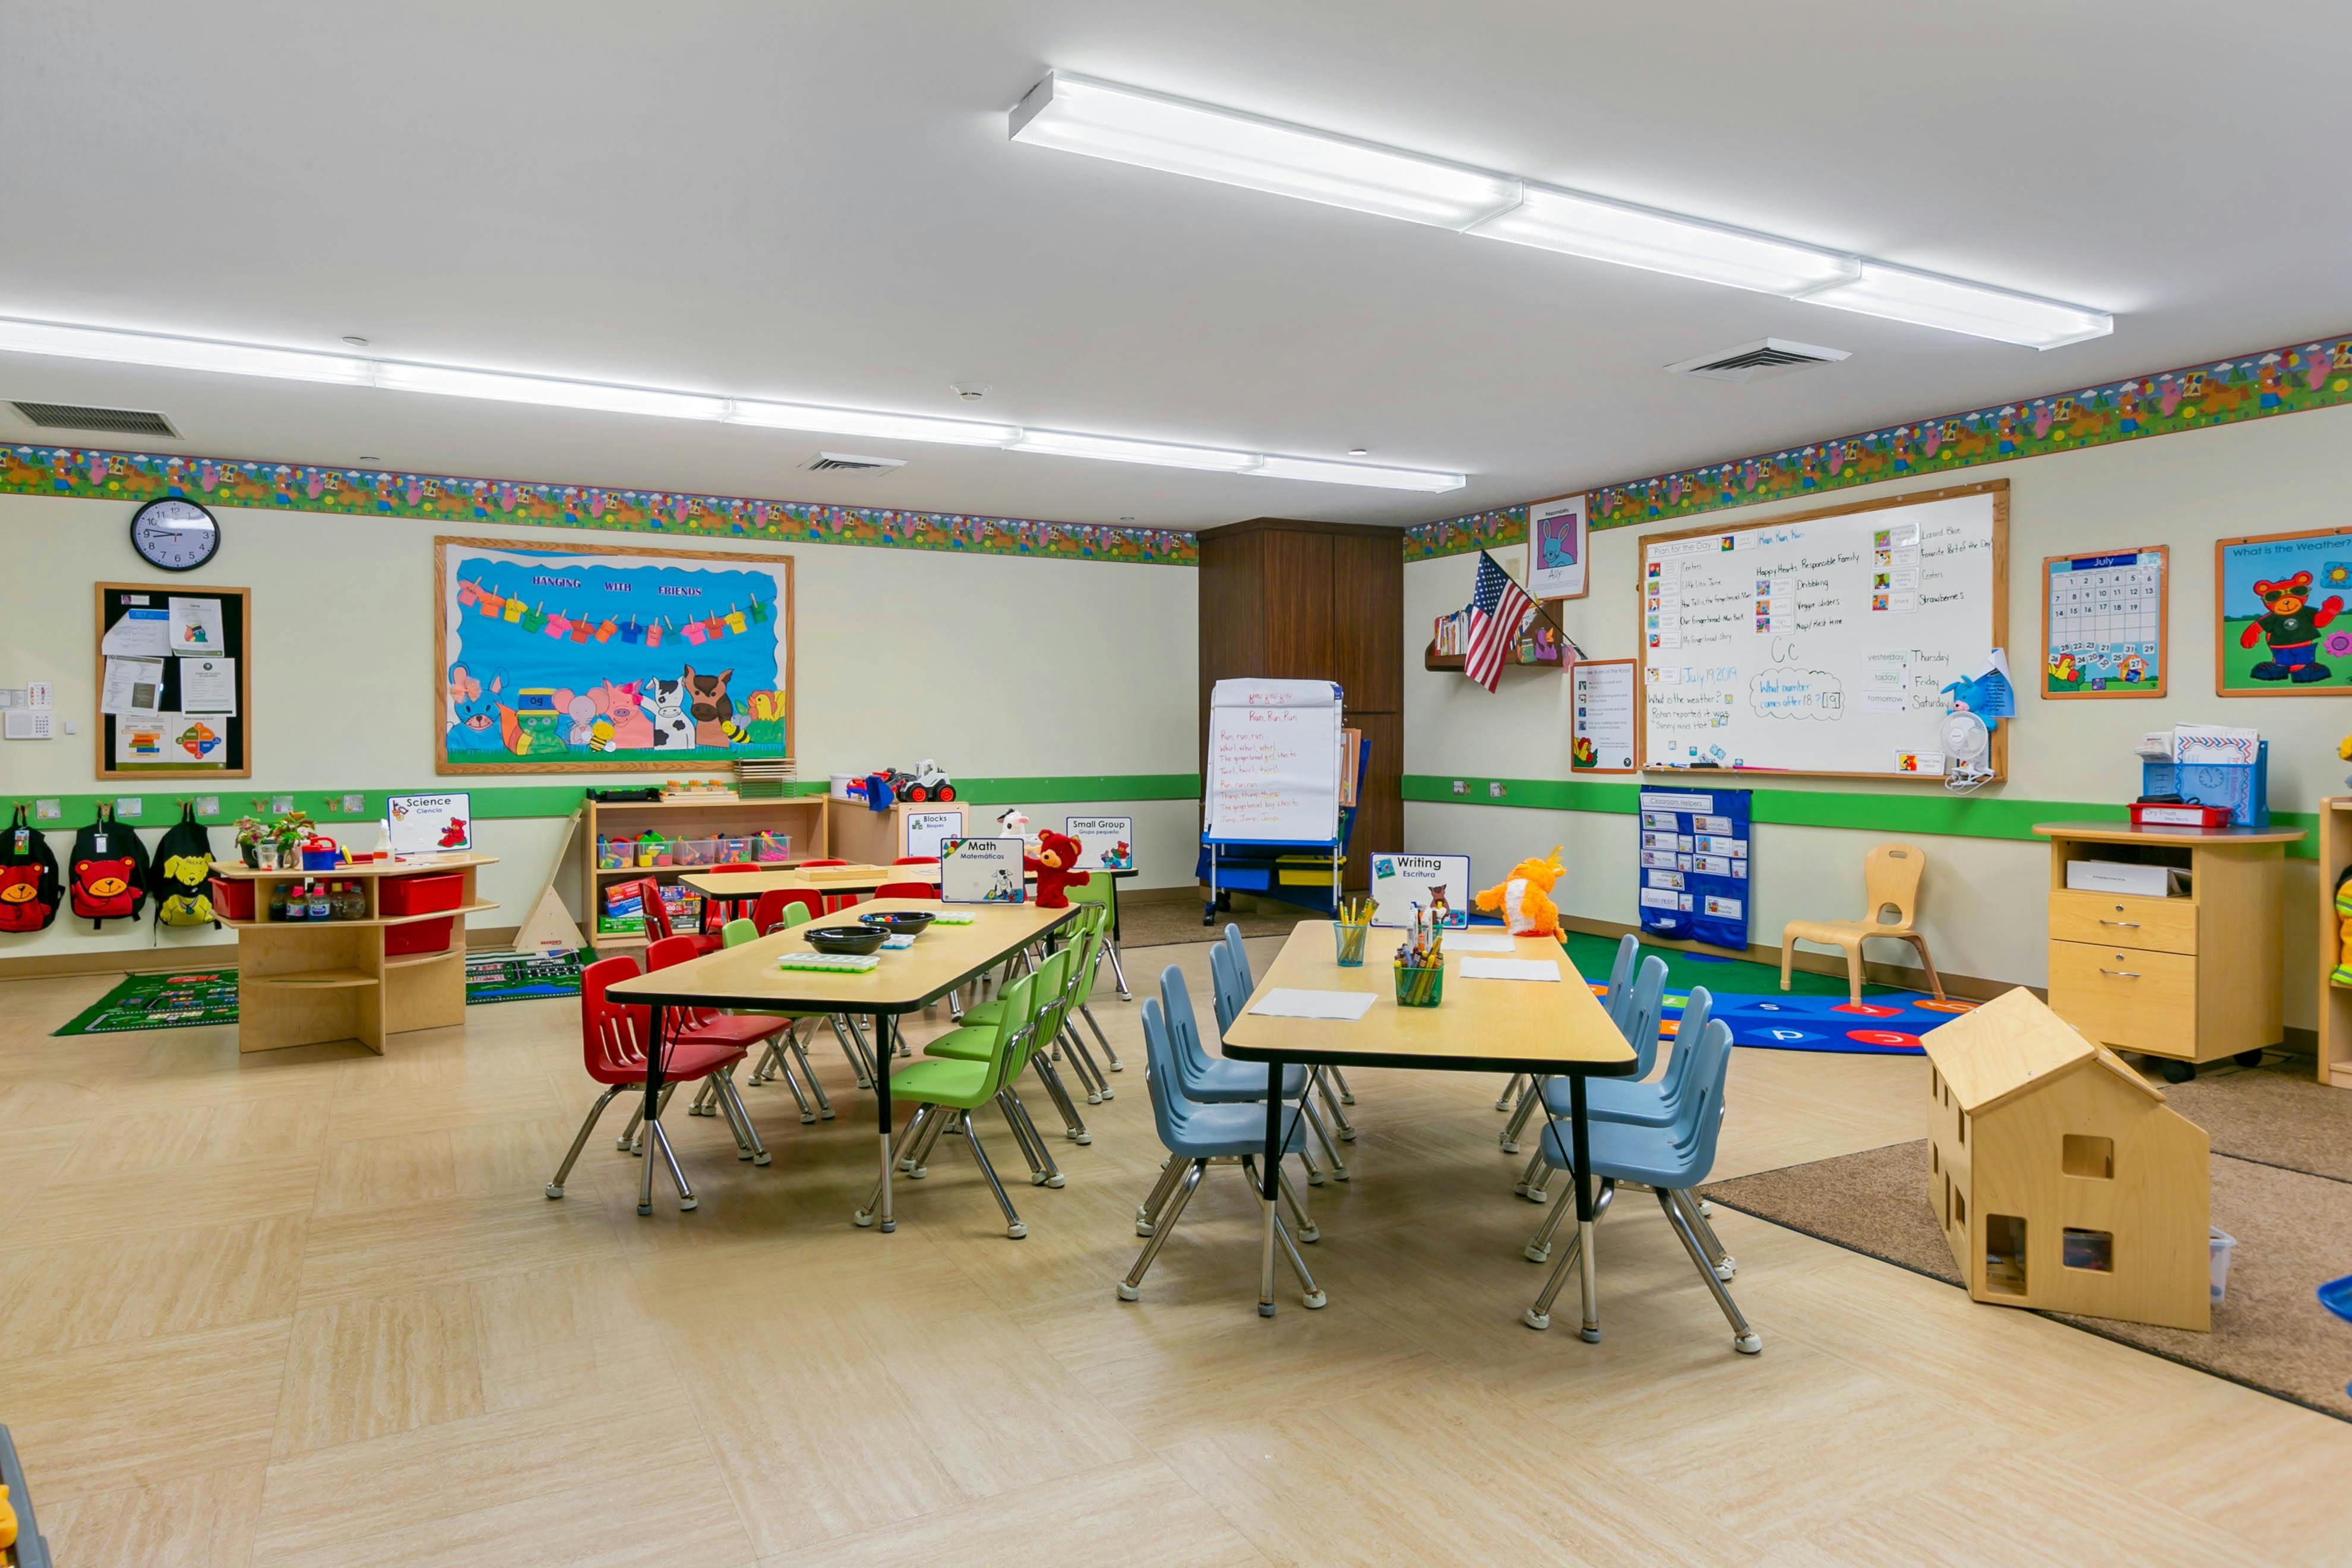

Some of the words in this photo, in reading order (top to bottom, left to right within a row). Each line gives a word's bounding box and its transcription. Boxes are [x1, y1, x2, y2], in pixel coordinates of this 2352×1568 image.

[203, 531, 209, 539] 3
[1921, 530, 1943, 540] Lizard
[1696, 541, 1712, 550] Day
[1948, 545, 1958, 554] Part
[1959, 540, 1967, 552] of
[2233, 546, 2262, 557] What
[2264, 545, 2272, 554] is
[2275, 544, 2293, 553] the
[2296, 538, 2352, 551] Weather?
[1757, 566, 1776, 577] Happy
[1778, 563, 1798, 573] Hearts
[1801, 557, 1836, 570] Responsible
[1838, 552, 1860, 564] Family
[2094, 558, 2114, 566] July
[1548, 570, 1562, 580] Ally
[1921, 570, 1943, 580] Centers
[532, 576, 581, 588] HANGING
[605, 581, 631, 592] WITH
[657, 586, 702, 596] FRIENDS
[1797, 579, 1829, 590] Dribbling
[1797, 601, 1816, 612] Veggie
[1868, 654, 1904, 663] yesterday
[1911, 650, 1949, 666] Thursday
[2100, 659, 2109, 668] 30
[1683, 667, 1705, 690] July
[1875, 673, 1896, 682] today
[1760, 679, 1779, 693] What
[1782, 679, 1811, 692] number
[1915, 676, 1939, 690] Friday
[530, 697, 542, 706] Og
[1648, 693, 1664, 703] What
[1673, 693, 1685, 703] the
[1687, 691, 1721, 703] weather?
[1868, 695, 1903, 703] tomorrow
[1760, 701, 1781, 710] comes
[1782, 696, 1801, 706] after
[1826, 695, 1837, 708] 19
[1912, 695, 1949, 710] Saturday
[1249, 710, 1266, 722] Run,
[1673, 710, 1702, 720] reported
[1704, 709, 1710, 717] it
[407, 798, 451, 807] Science
[1650, 797, 1680, 807] Classroom
[1680, 799, 1703, 807] Helpers
[2145, 808, 2158, 817] Dry
[1099, 821, 1125, 830] Group
[968, 841, 996, 851] Math
[960, 852, 1004, 860] Matemáticas
[1398, 857, 1441, 871] Writing
